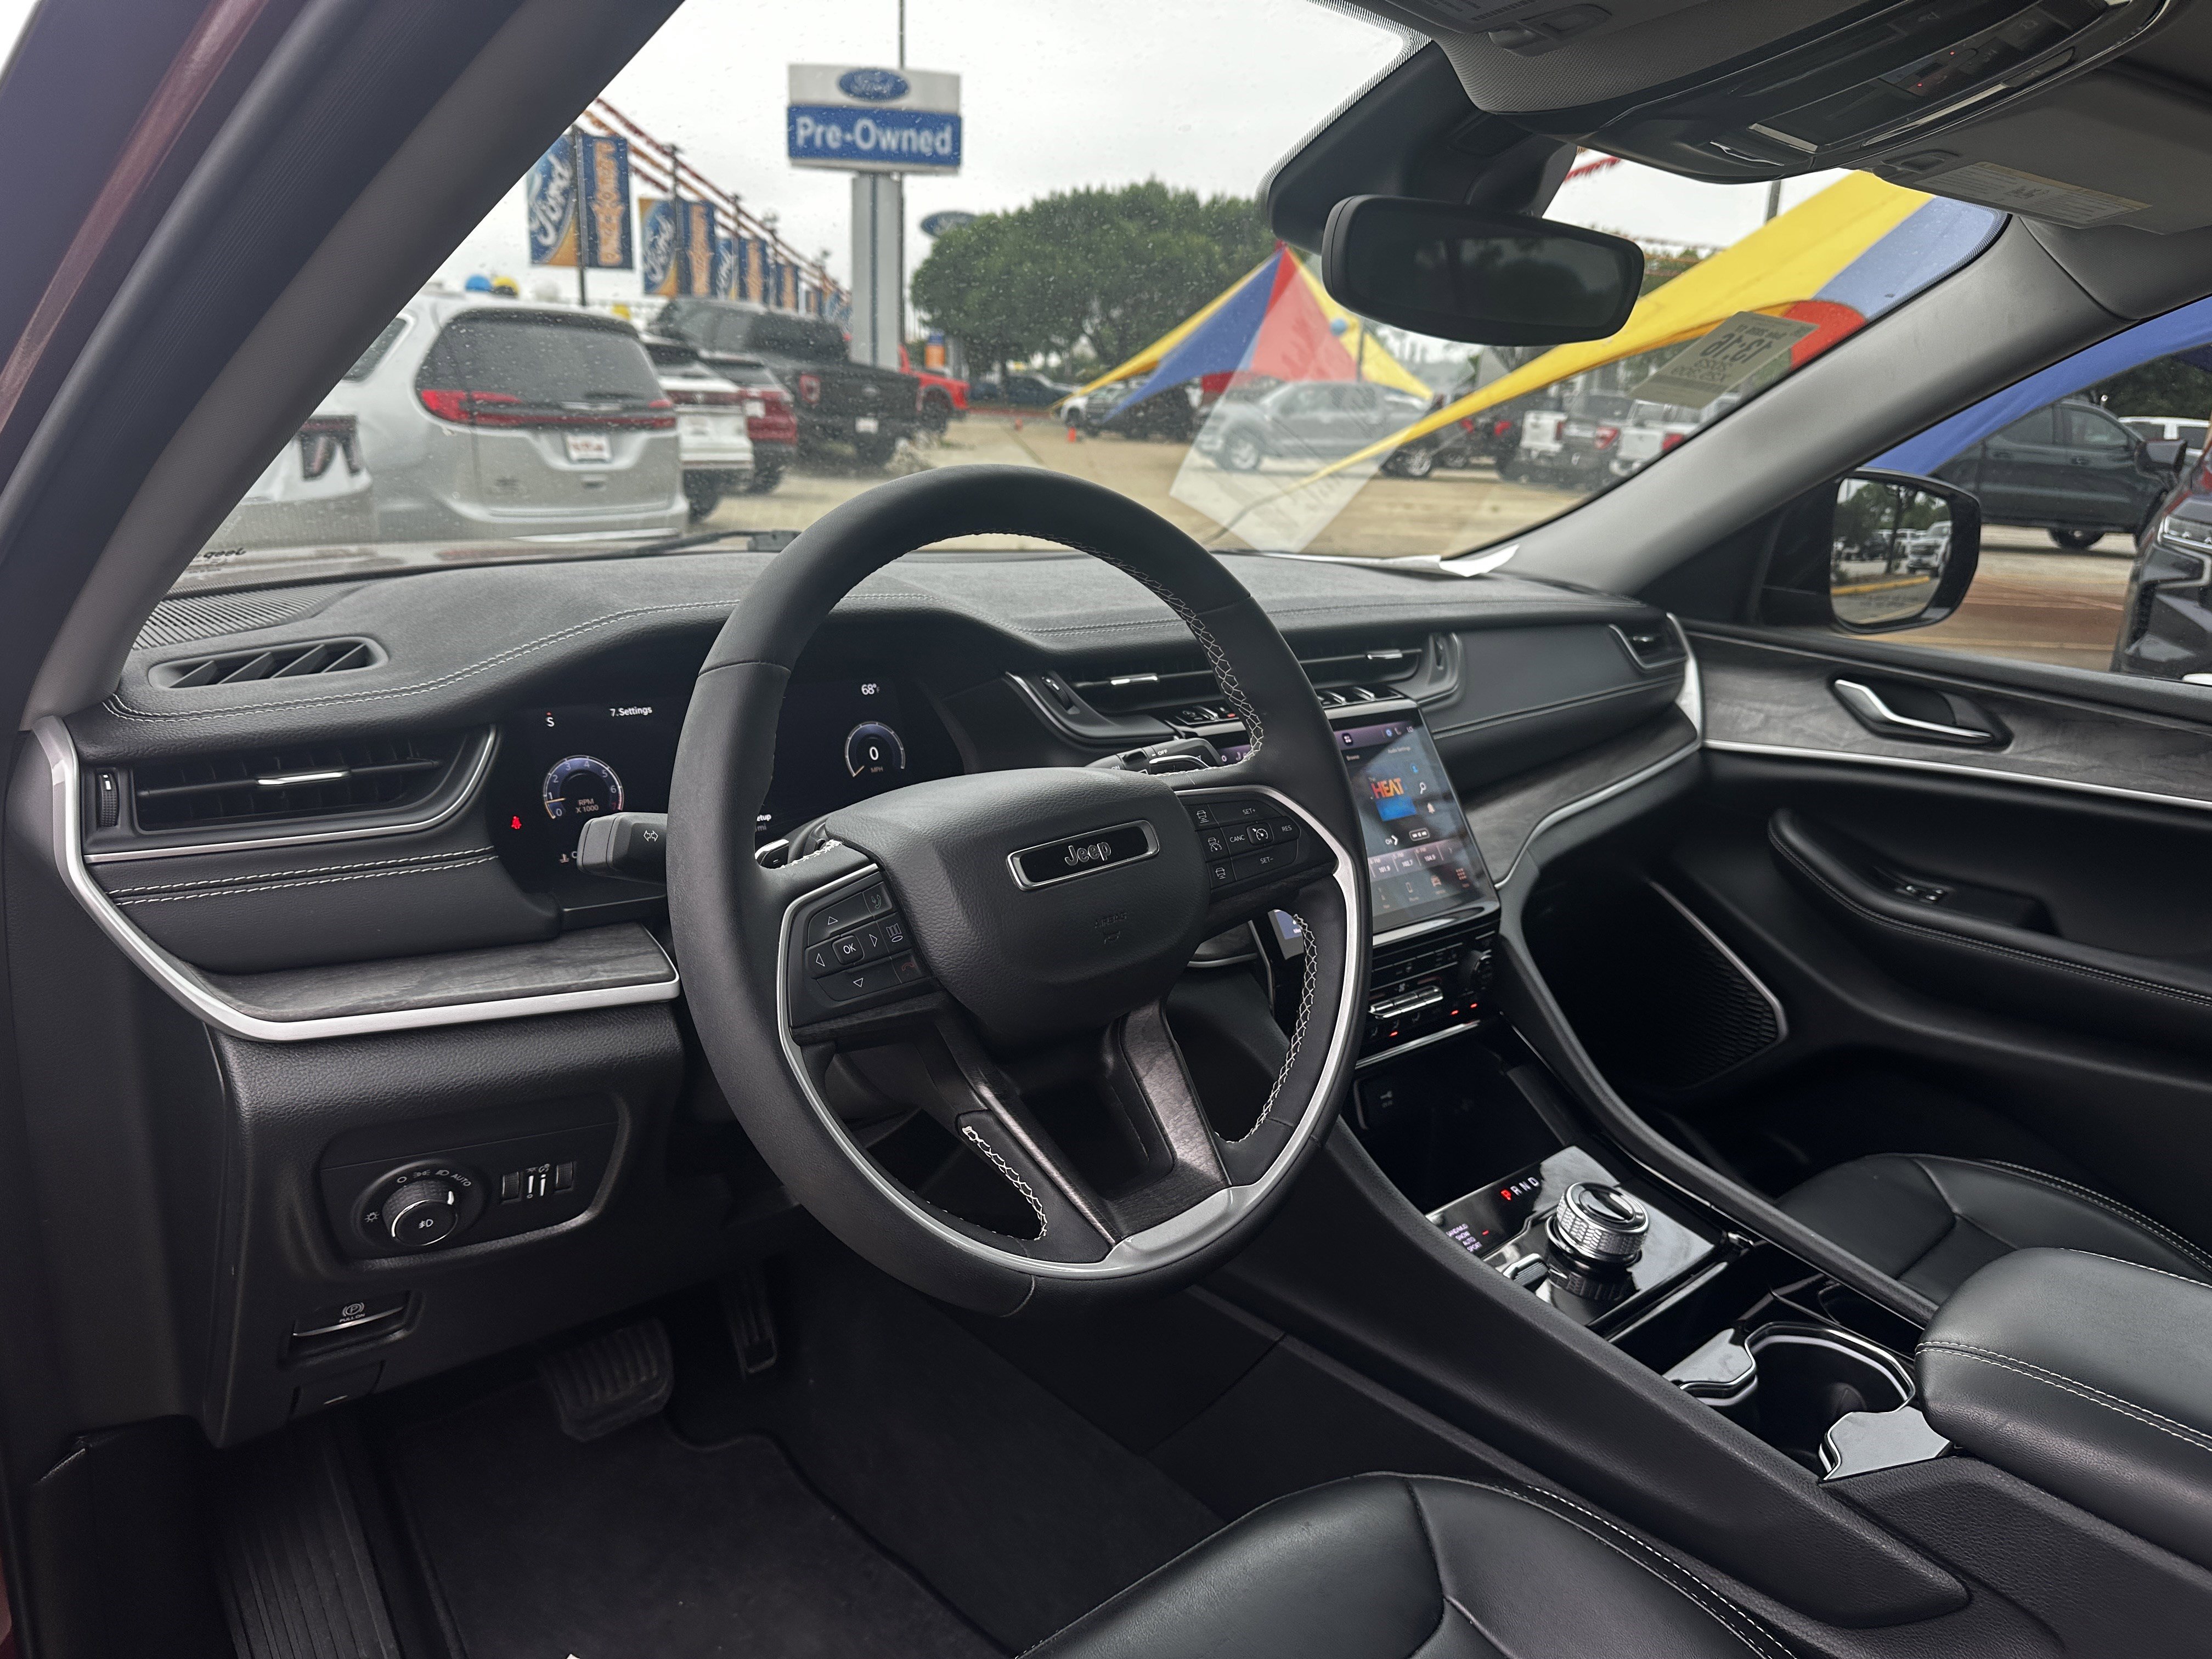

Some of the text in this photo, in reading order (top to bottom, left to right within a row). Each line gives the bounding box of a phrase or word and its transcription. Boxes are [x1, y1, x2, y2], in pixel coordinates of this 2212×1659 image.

[796, 115, 953, 156] Pre-Owned
[546, 716, 555, 727] S
[869, 746, 879, 760] 0
[566, 762, 572, 771] 3
[552, 775, 559, 783] 2
[611, 785, 617, 793] 6
[1370, 777, 1404, 799] HEAT
[556, 808, 562, 817] 0
[583, 804, 599, 812] 1000
[1229, 834, 1245, 843] CANC
[1064, 841, 1111, 866] Jeep
[843, 943, 856, 954] OK
[450, 1173, 471, 1187] AUTO
[1501, 1177, 1540, 1201] P R N D
